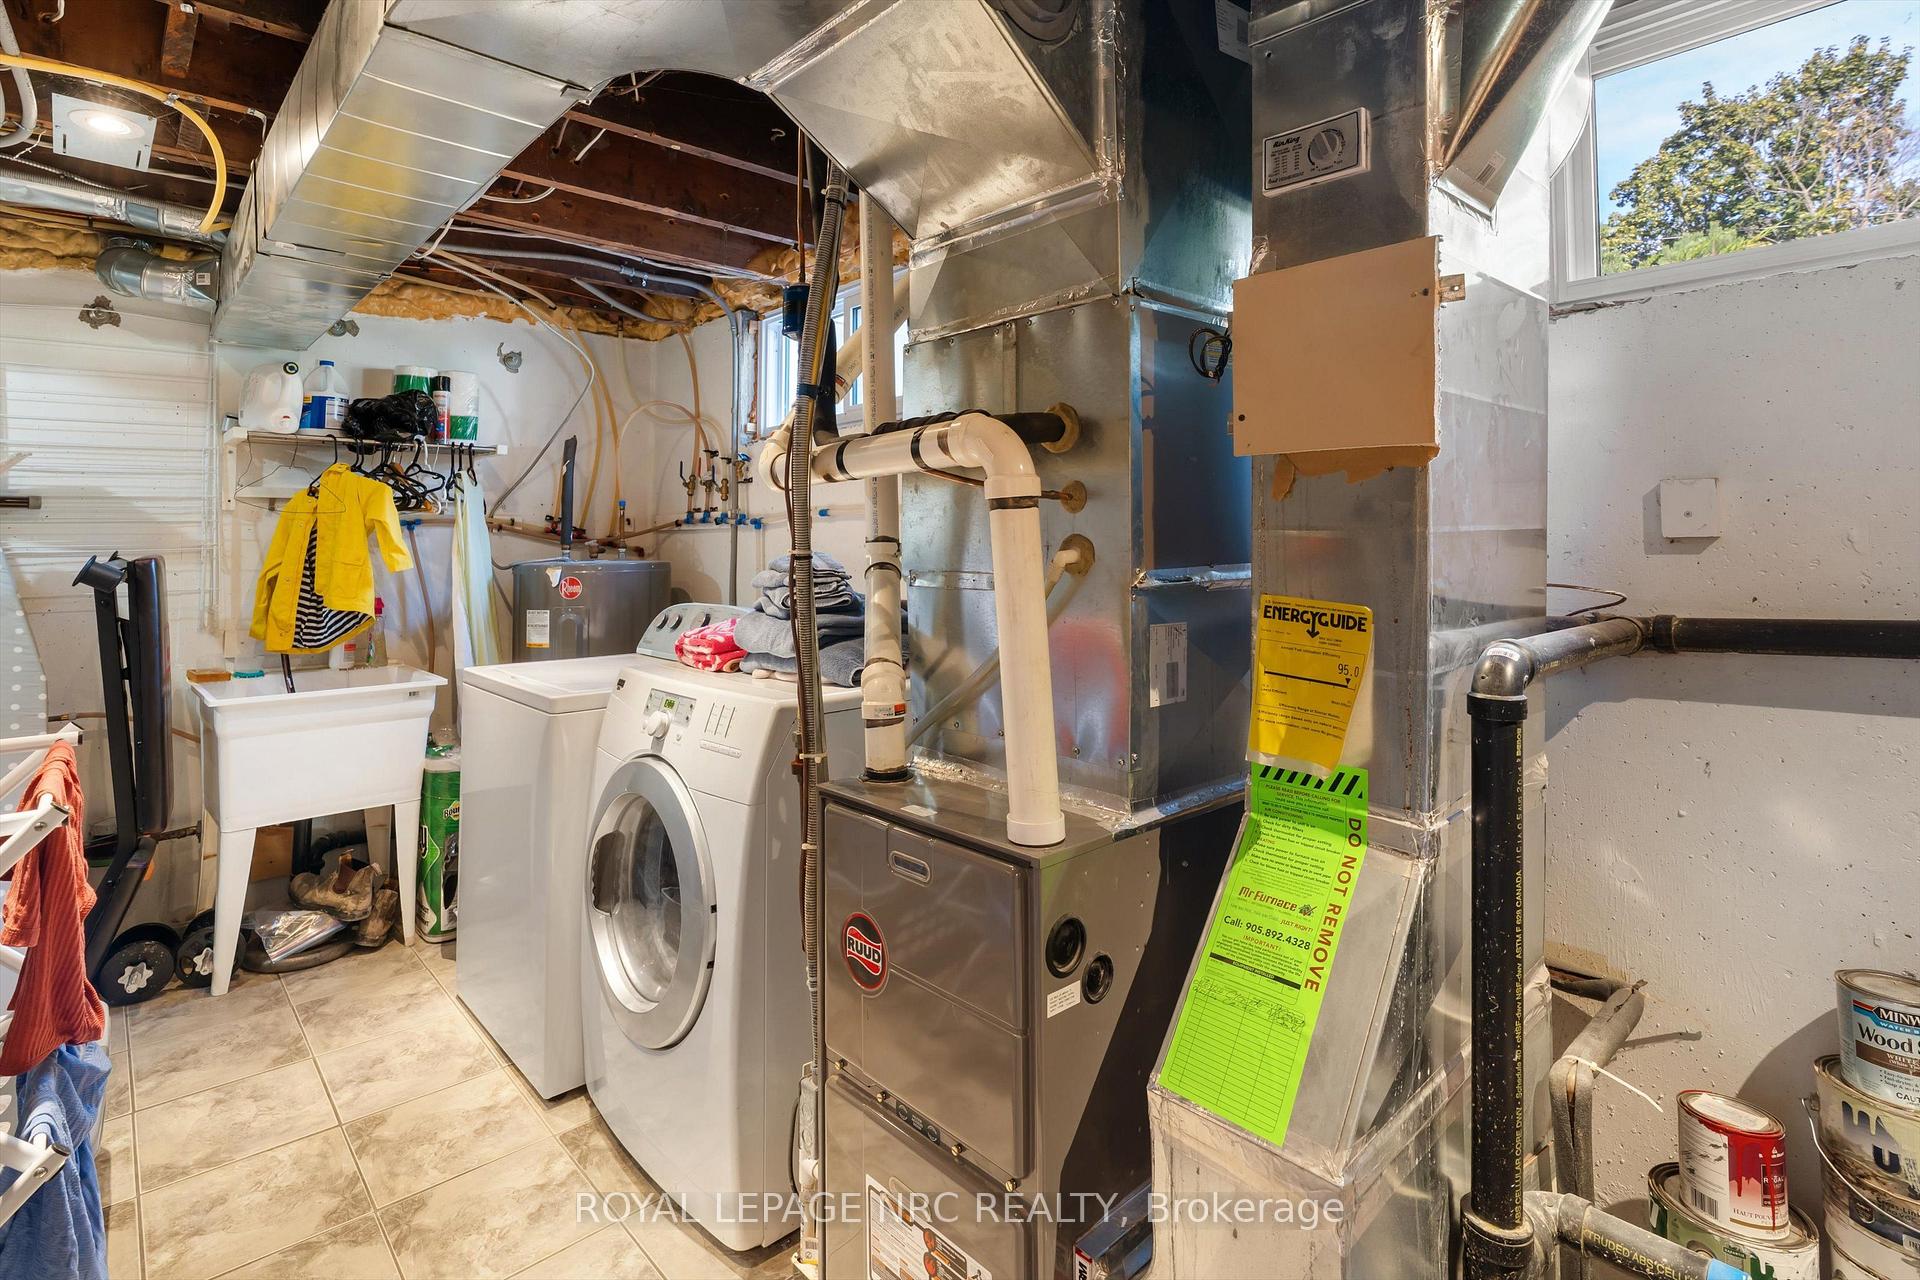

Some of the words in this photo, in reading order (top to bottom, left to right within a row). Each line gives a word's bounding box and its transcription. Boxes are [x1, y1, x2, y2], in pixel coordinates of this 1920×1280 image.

[1263, 605, 1368, 635] ENERGYGUIDE
[1337, 663, 1360, 677] 95.0
[1347, 818, 1362, 848] DO
[1334, 855, 1358, 897] NOT
[1239, 886, 1254, 897] Mr
[1253, 890, 1298, 912] Furnace
[1224, 915, 1243, 928] Call:
[1245, 922, 1311, 950] 905.892.4328
[1280, 919, 1294, 927] JUST
[847, 936, 881, 964] RUUD
[1304, 903, 1343, 993] REMOVE
[1857, 1022, 1914, 1054] Wood
[1632, 1251, 1654, 1271] ABS
